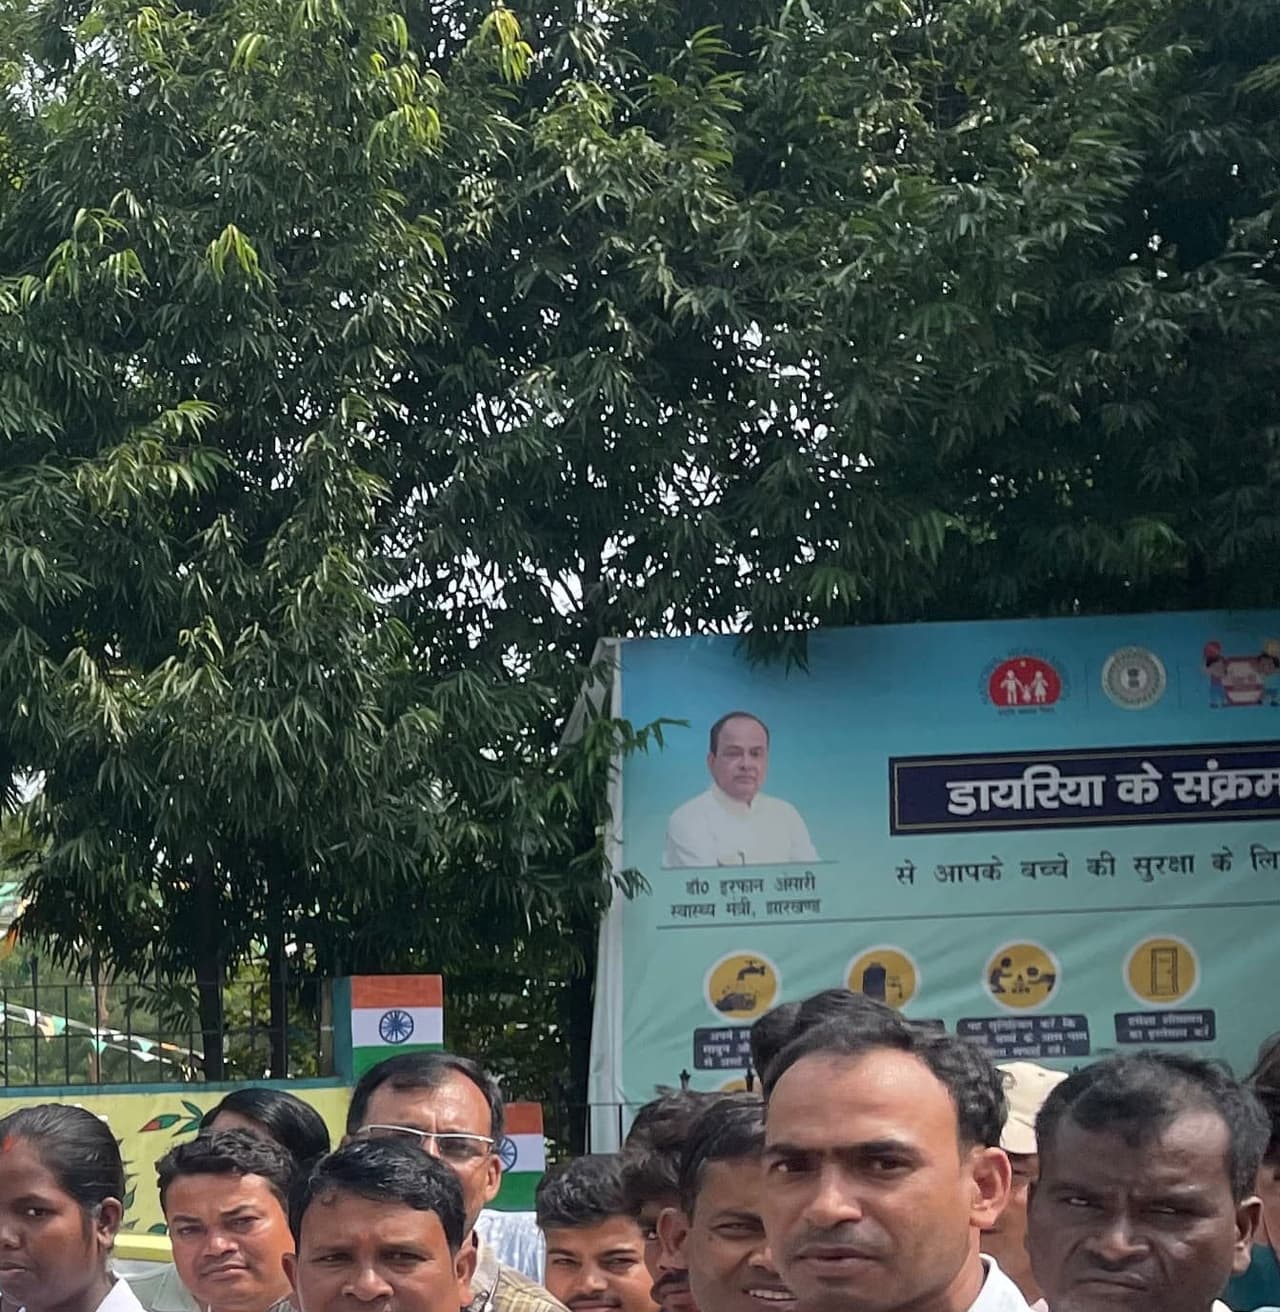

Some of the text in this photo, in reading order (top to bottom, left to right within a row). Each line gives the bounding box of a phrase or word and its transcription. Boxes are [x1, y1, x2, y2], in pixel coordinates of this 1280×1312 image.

[945, 764, 1107, 817] डायरिया
[1115, 760, 1162, 804] के
[896, 858, 918, 885] से
[933, 855, 1004, 883] आपके
[1020, 852, 1069, 880] बच्चे
[1087, 849, 1116, 877] की
[1132, 853, 1195, 882] सुरक्षा
[1211, 846, 1234, 872] के
